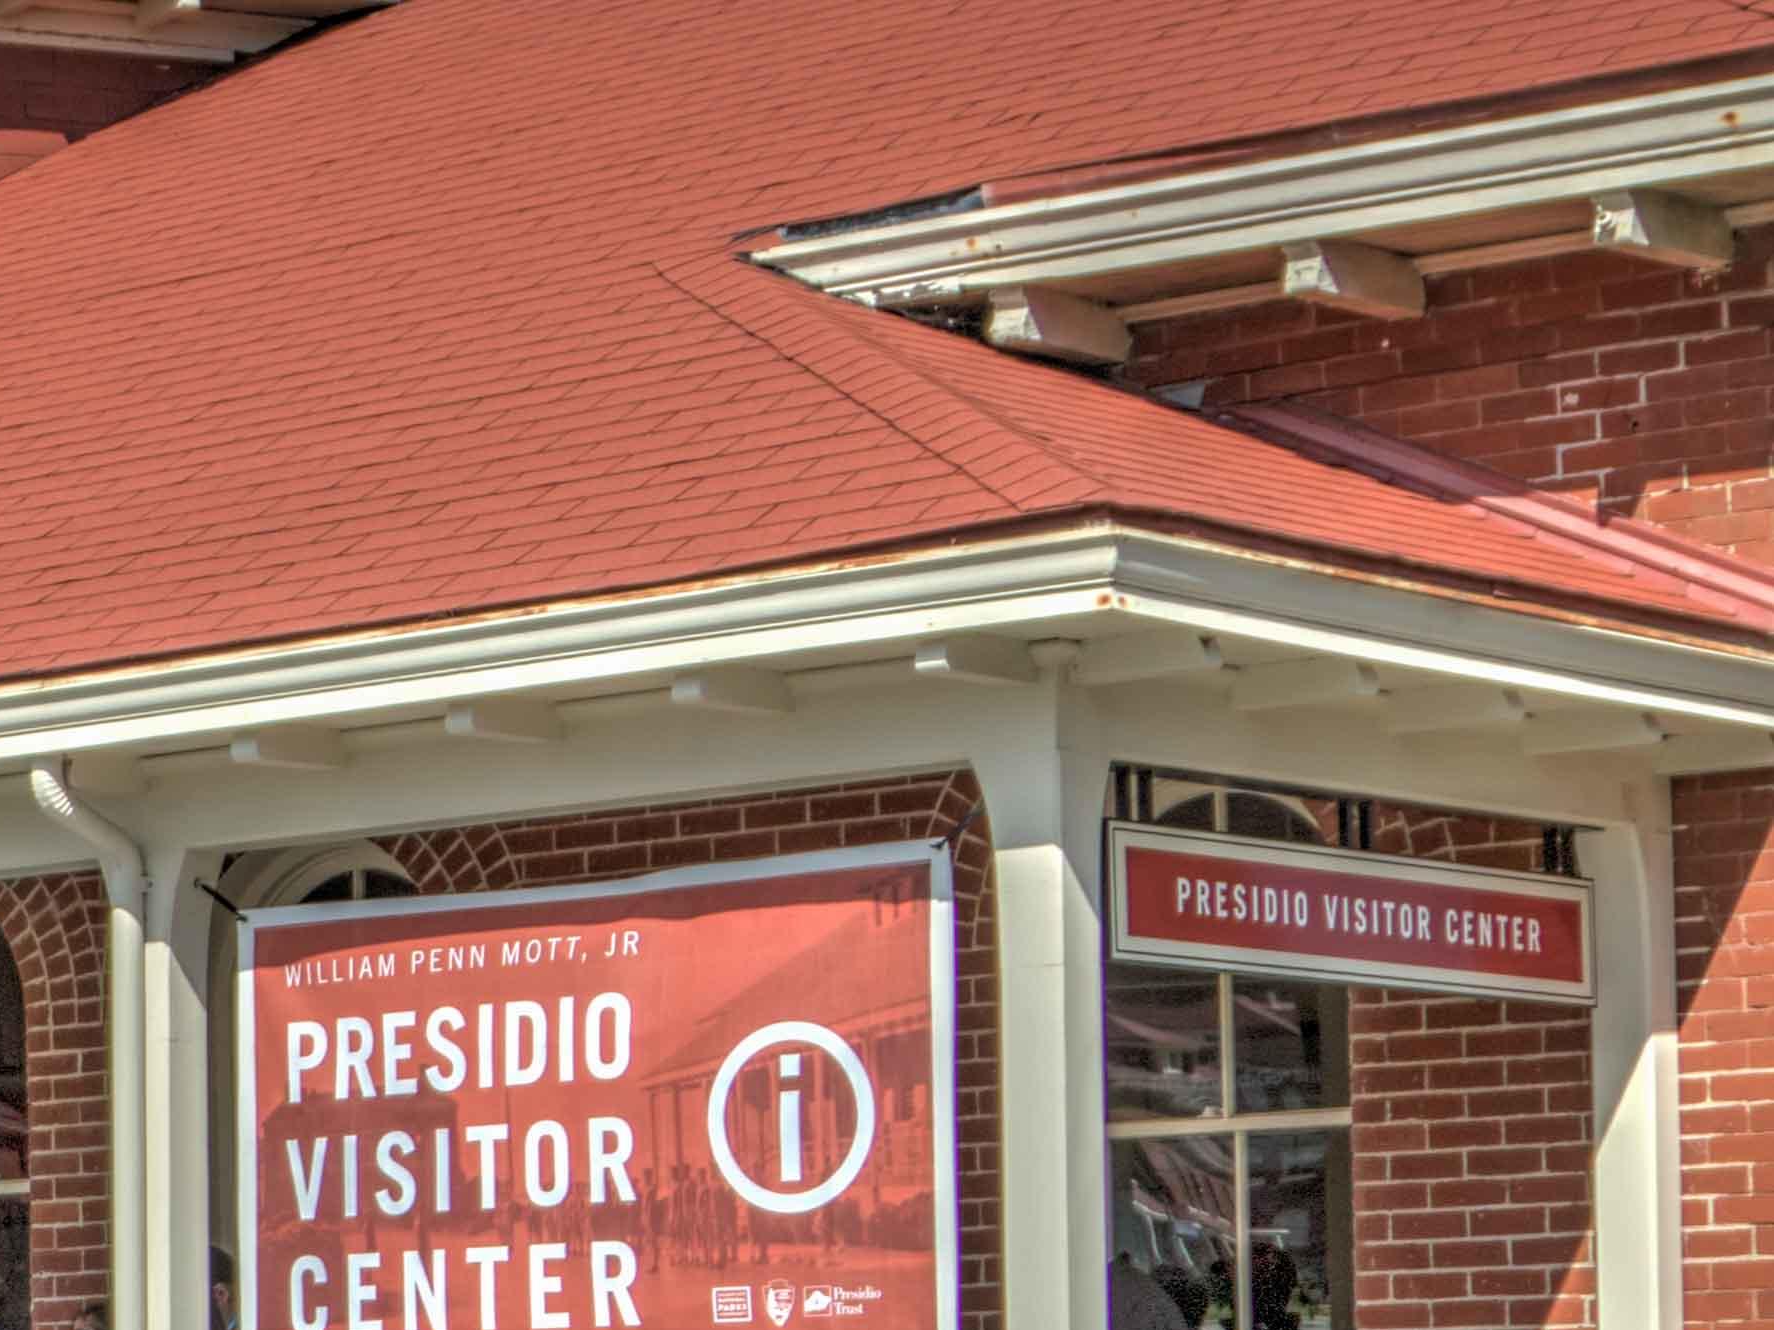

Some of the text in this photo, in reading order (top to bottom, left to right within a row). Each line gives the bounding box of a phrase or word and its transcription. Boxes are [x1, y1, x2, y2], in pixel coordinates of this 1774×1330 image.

[1176, 877, 1542, 953] PRESIDIO VISITOR CENTER
[284, 930, 640, 988] WILLIAM PENN MOTT, JR
[286, 991, 632, 1104] PRESIDIO
[286, 1116, 637, 1221] VISITOR
[833, 1285, 882, 1300] Presidio
[834, 1302, 864, 1315] Trust
